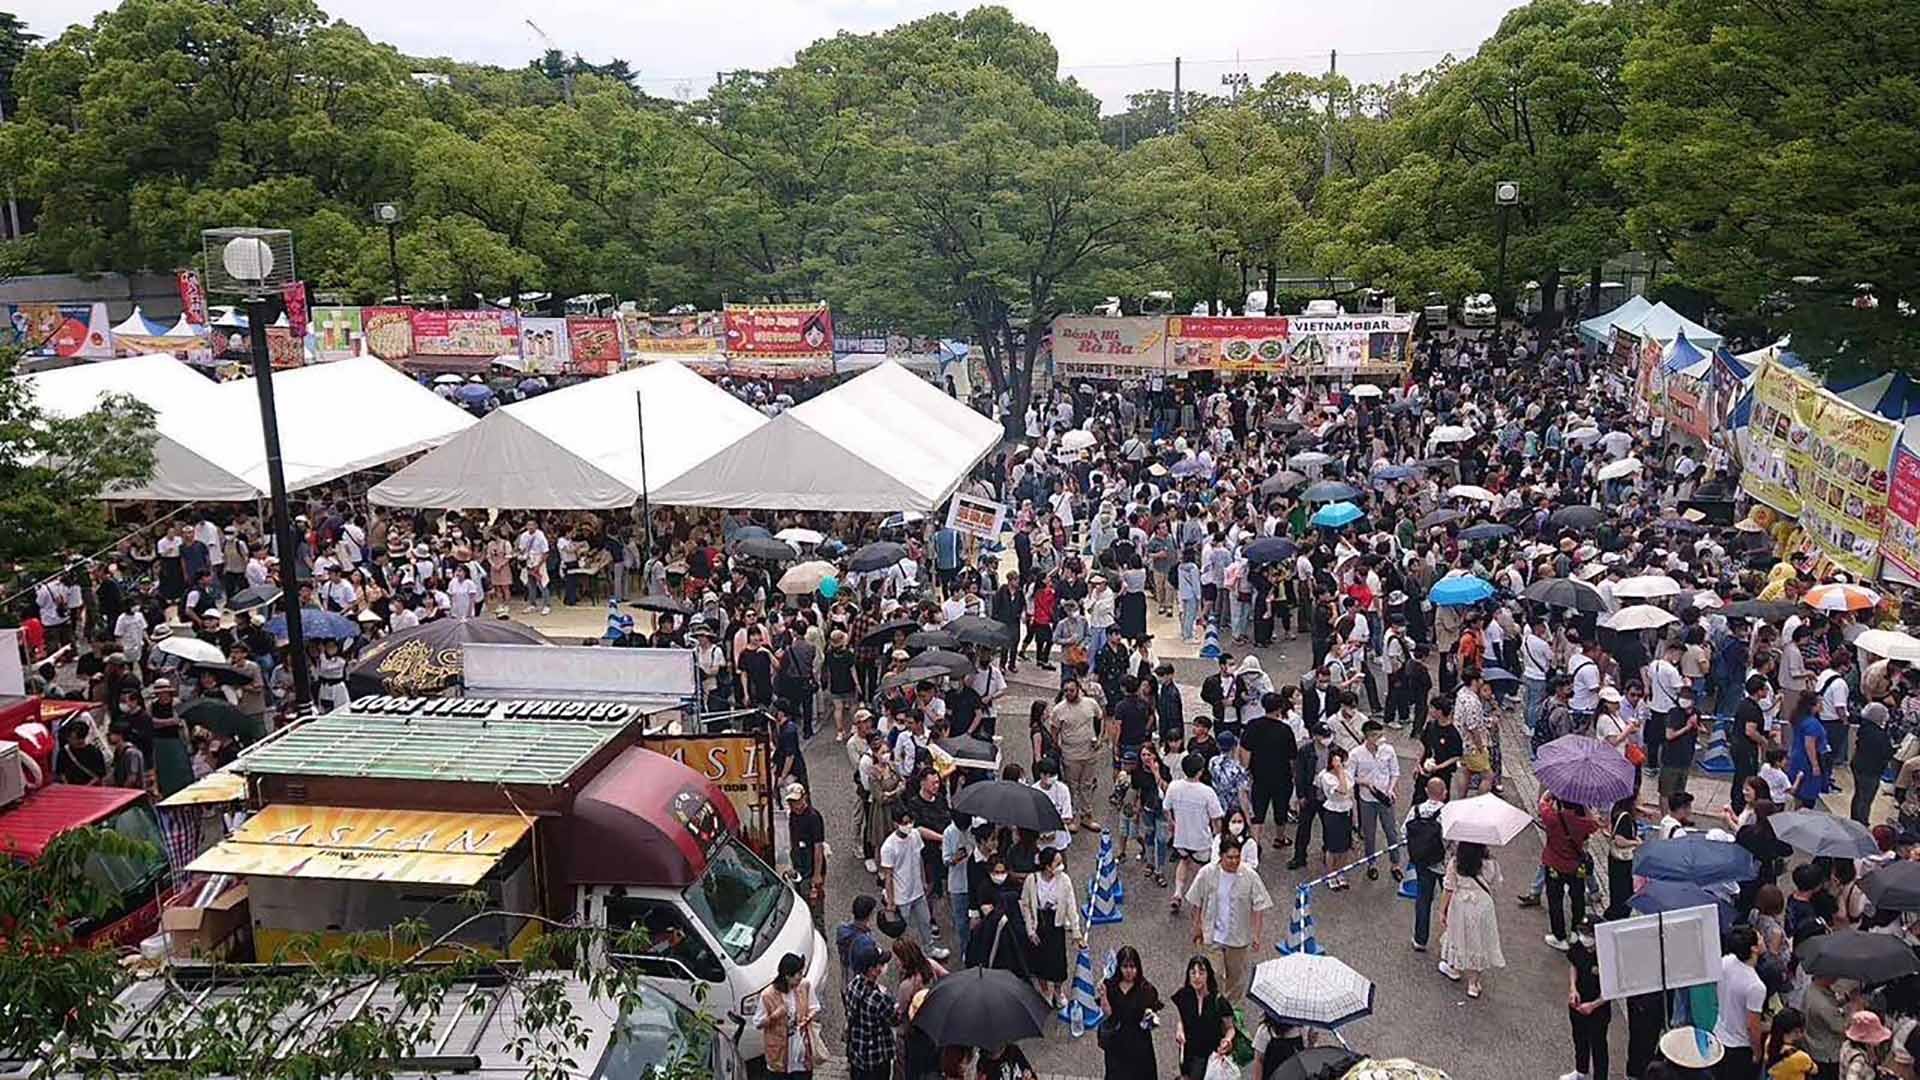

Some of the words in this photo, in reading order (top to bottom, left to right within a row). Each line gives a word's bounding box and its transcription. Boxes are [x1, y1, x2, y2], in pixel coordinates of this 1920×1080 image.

[1294, 320, 1353, 332] VIETNAM
[1363, 320, 1391, 331] BAR
[350, 694, 427, 714] FOOD
[265, 825, 499, 852] ASIAN
